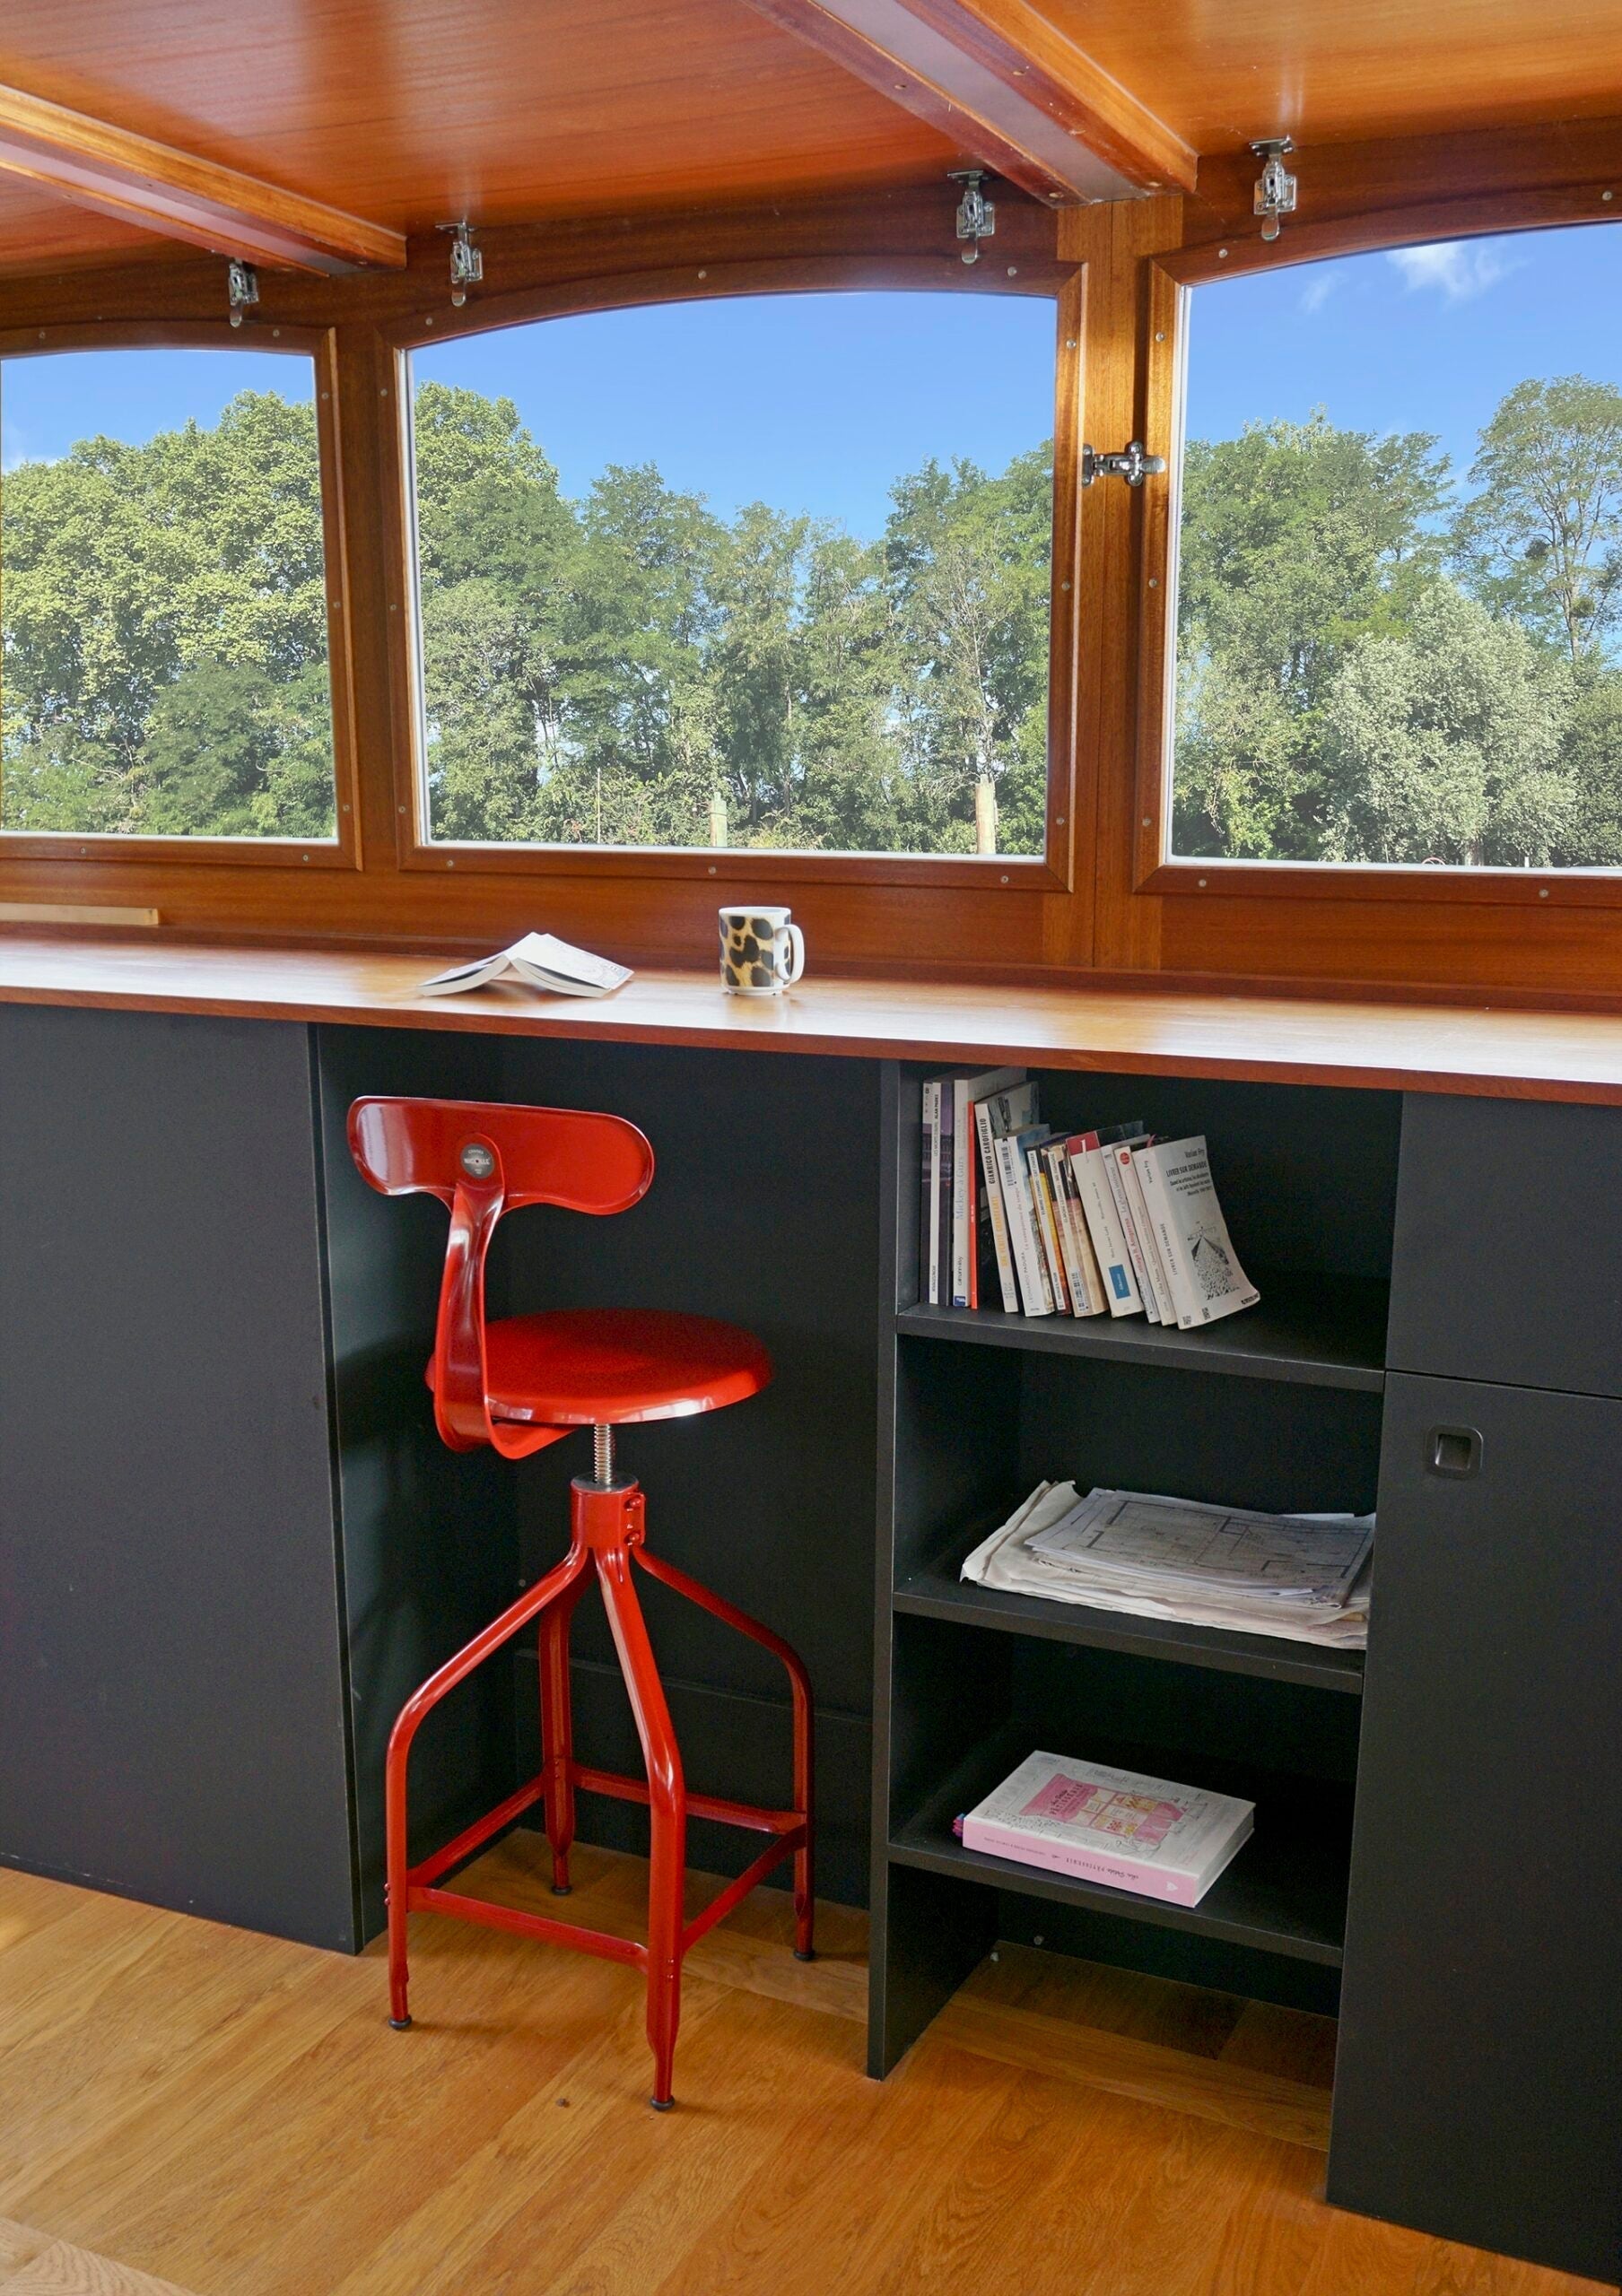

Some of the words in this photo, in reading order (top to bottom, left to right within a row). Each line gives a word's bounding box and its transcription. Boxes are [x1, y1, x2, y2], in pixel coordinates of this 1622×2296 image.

[979, 1118, 991, 1154] CAROFIGLIO
[985, 1155, 996, 1185] GIANRICO
[1166, 1166, 1180, 1177] LIVRER
[1189, 1161, 1208, 1171] DEMANDE
[955, 1189, 965, 1220] Mickey
[1160, 1223, 1170, 1248] DEMANDE
[1169, 1258, 1178, 1276] LIVRER
